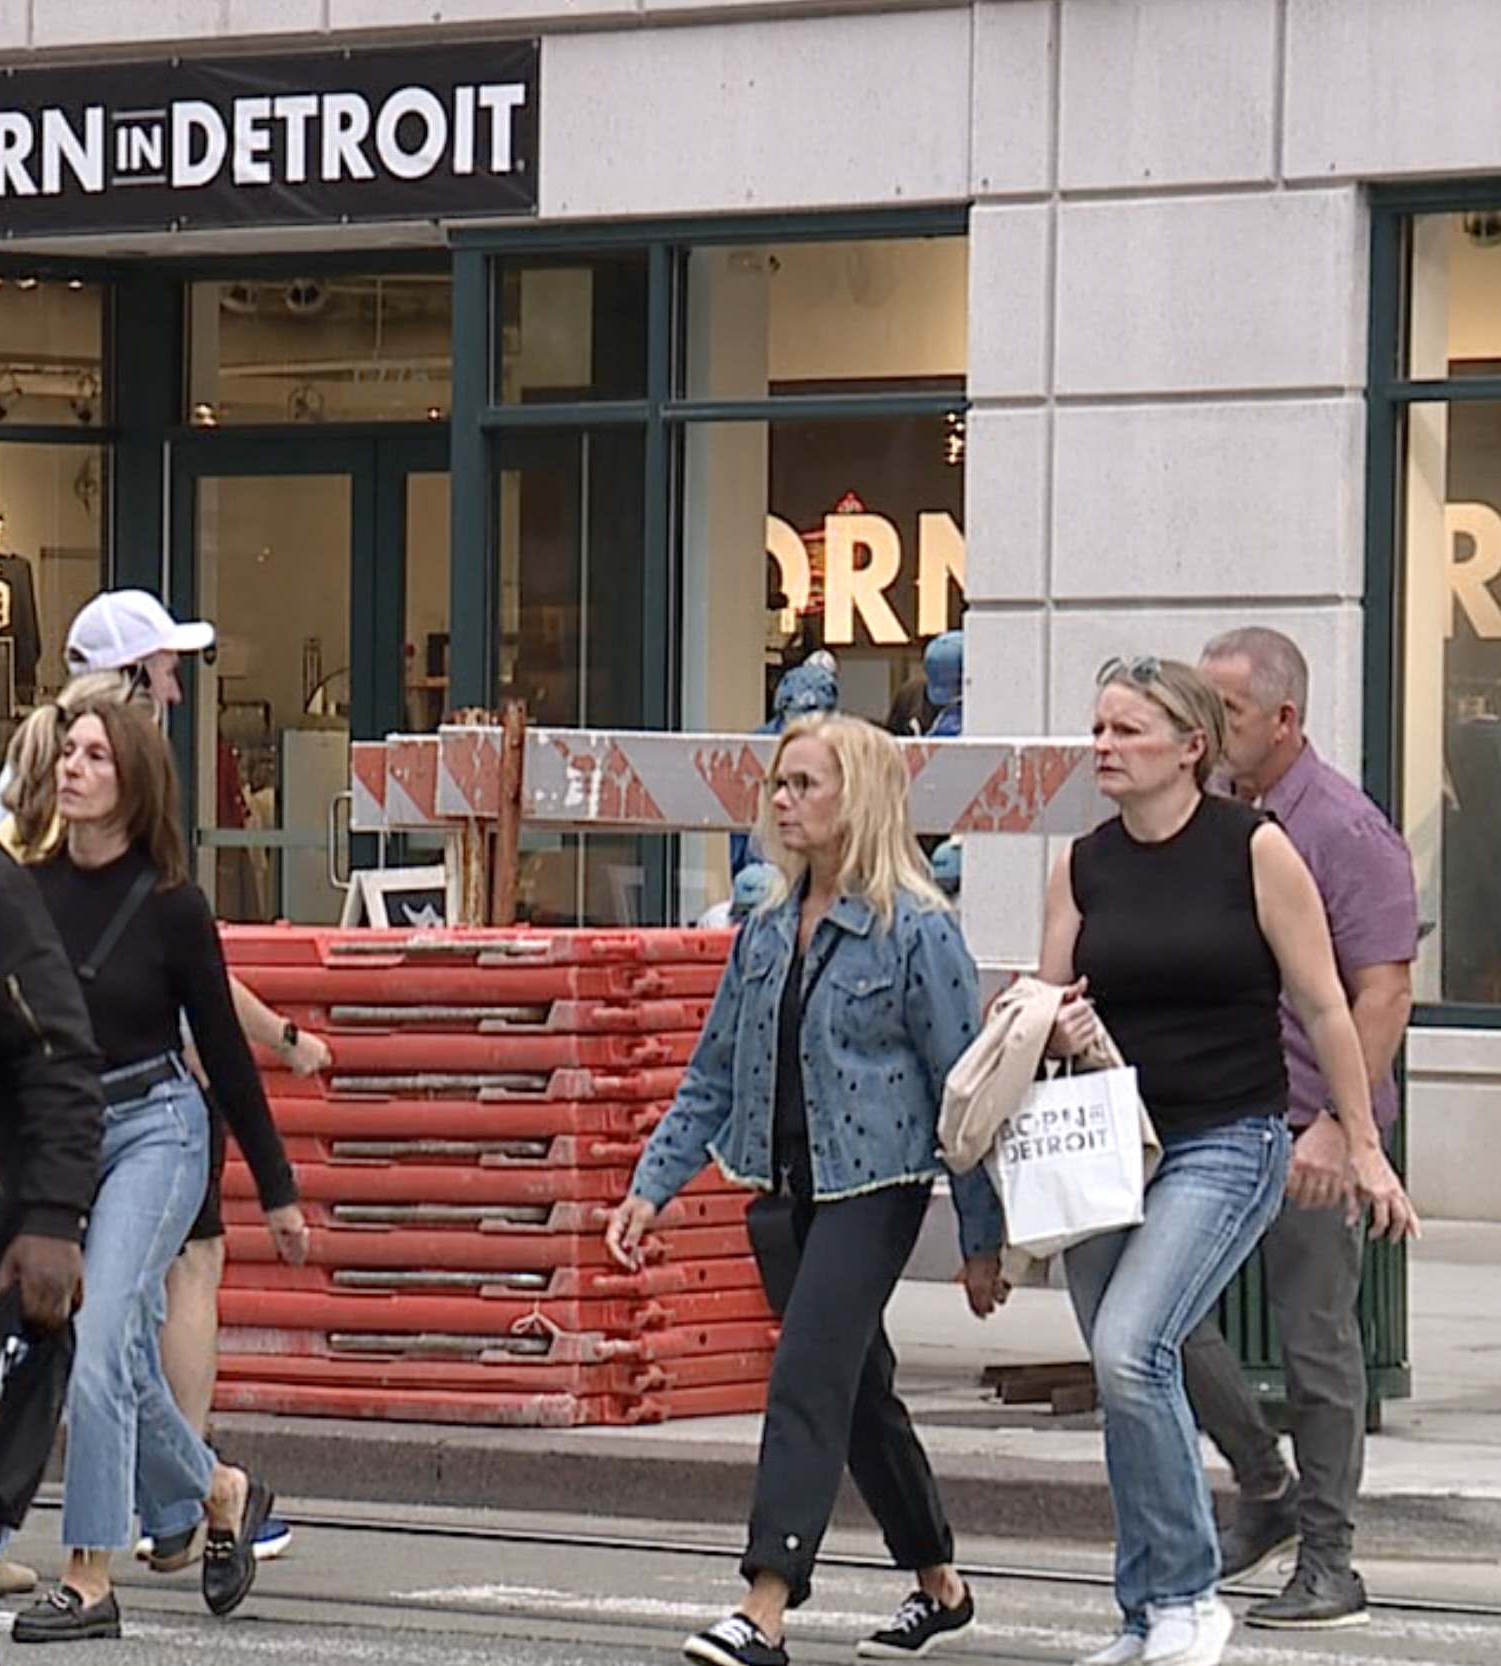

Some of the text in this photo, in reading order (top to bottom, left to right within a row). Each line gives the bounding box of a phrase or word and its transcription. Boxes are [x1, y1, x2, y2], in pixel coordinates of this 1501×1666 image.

[116, 122, 164, 173] IN
[172, 84, 526, 186] DETROIT
[1004, 1128, 1108, 1164] DETROIT
